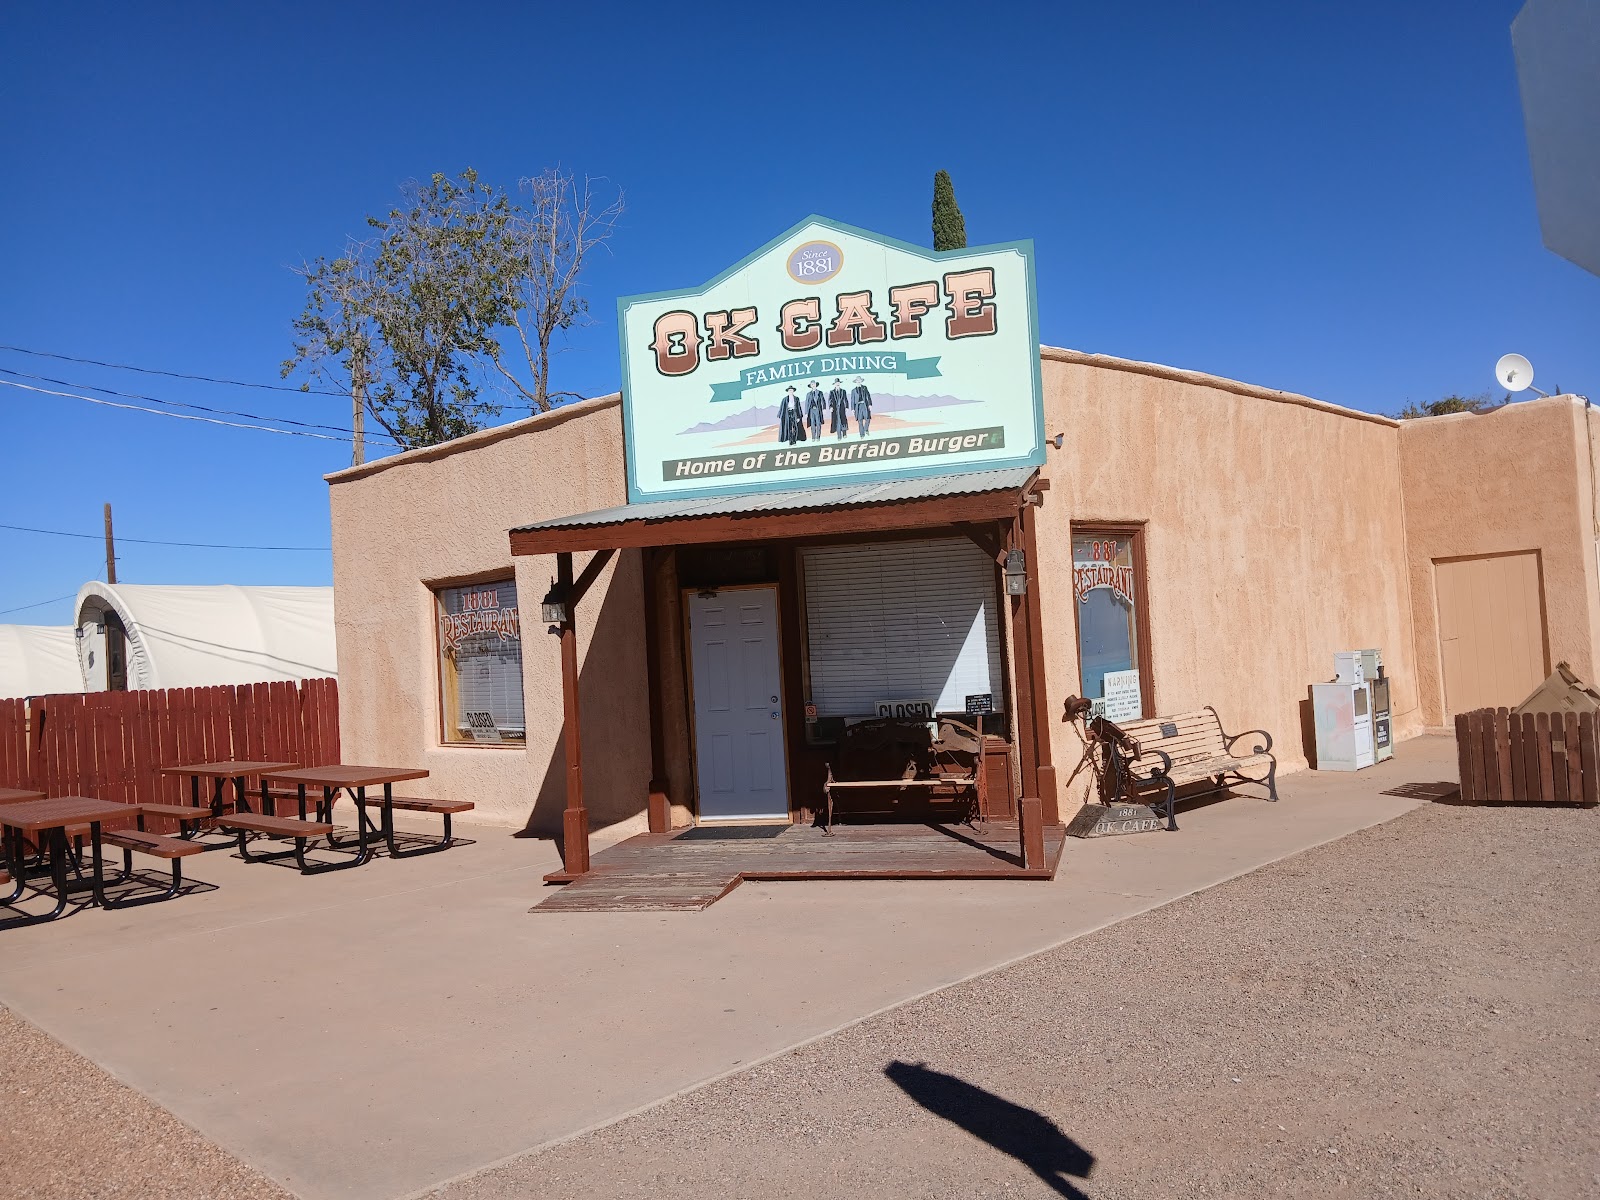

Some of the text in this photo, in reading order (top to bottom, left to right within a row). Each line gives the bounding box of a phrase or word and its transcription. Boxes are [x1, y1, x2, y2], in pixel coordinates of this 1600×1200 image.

[801, 249, 828, 260] Since
[796, 257, 834, 277] 1881
[648, 267, 998, 377] OK CAFE
[746, 355, 898, 386] FAMILY DINING
[675, 432, 989, 477] Home of the Buffalo Burger
[1072, 564, 1135, 606] RESTAURANT
[462, 589, 499, 611] 1881
[466, 711, 495, 728] CLOSED
[1119, 808, 1137, 816] 1881
[1122, 819, 1159, 832] CAFE
